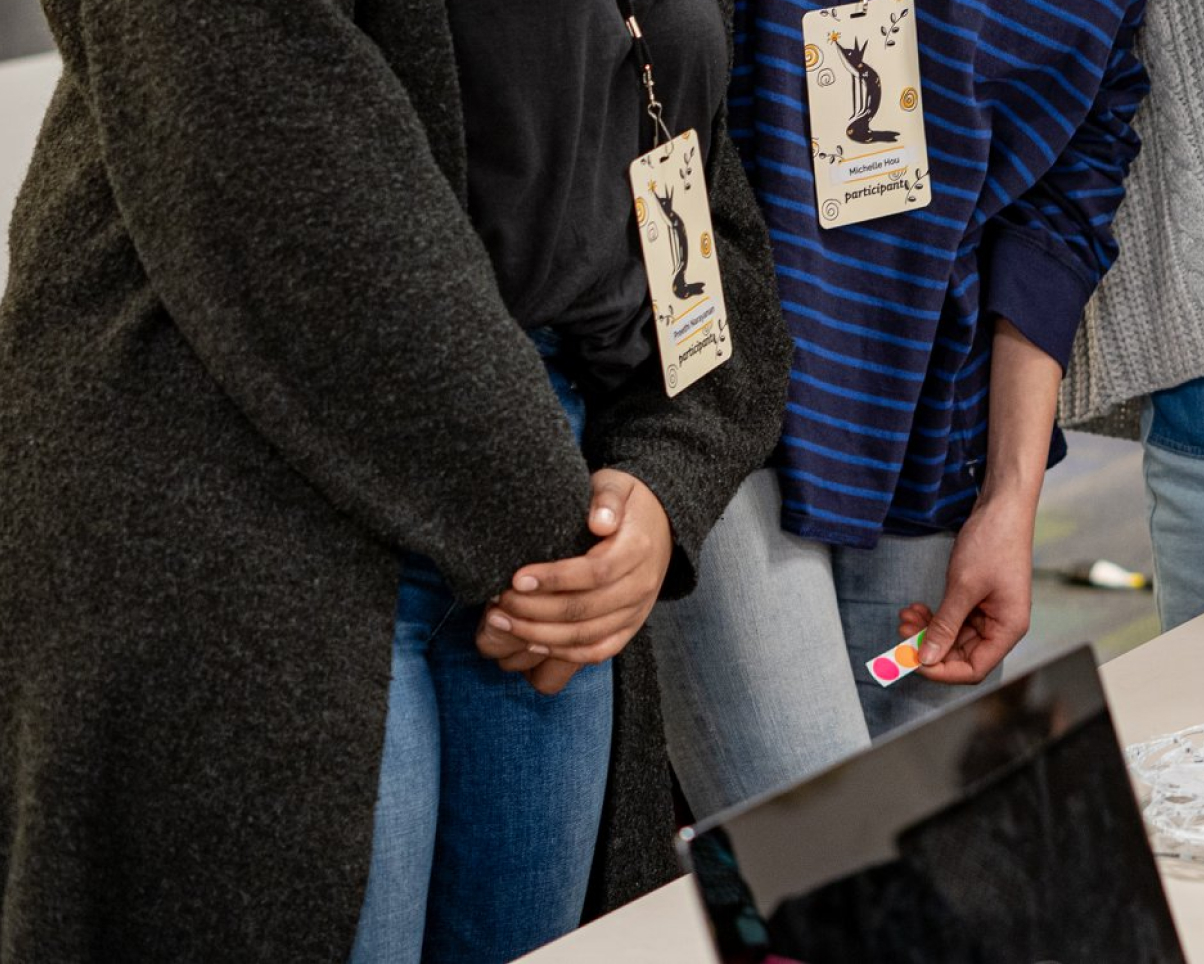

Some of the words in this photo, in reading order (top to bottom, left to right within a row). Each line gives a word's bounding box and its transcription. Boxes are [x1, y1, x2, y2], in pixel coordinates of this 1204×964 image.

[848, 160, 883, 176] Michelle
[884, 156, 900, 167] Hou
[844, 179, 904, 204] participant
[678, 333, 715, 368] participant
